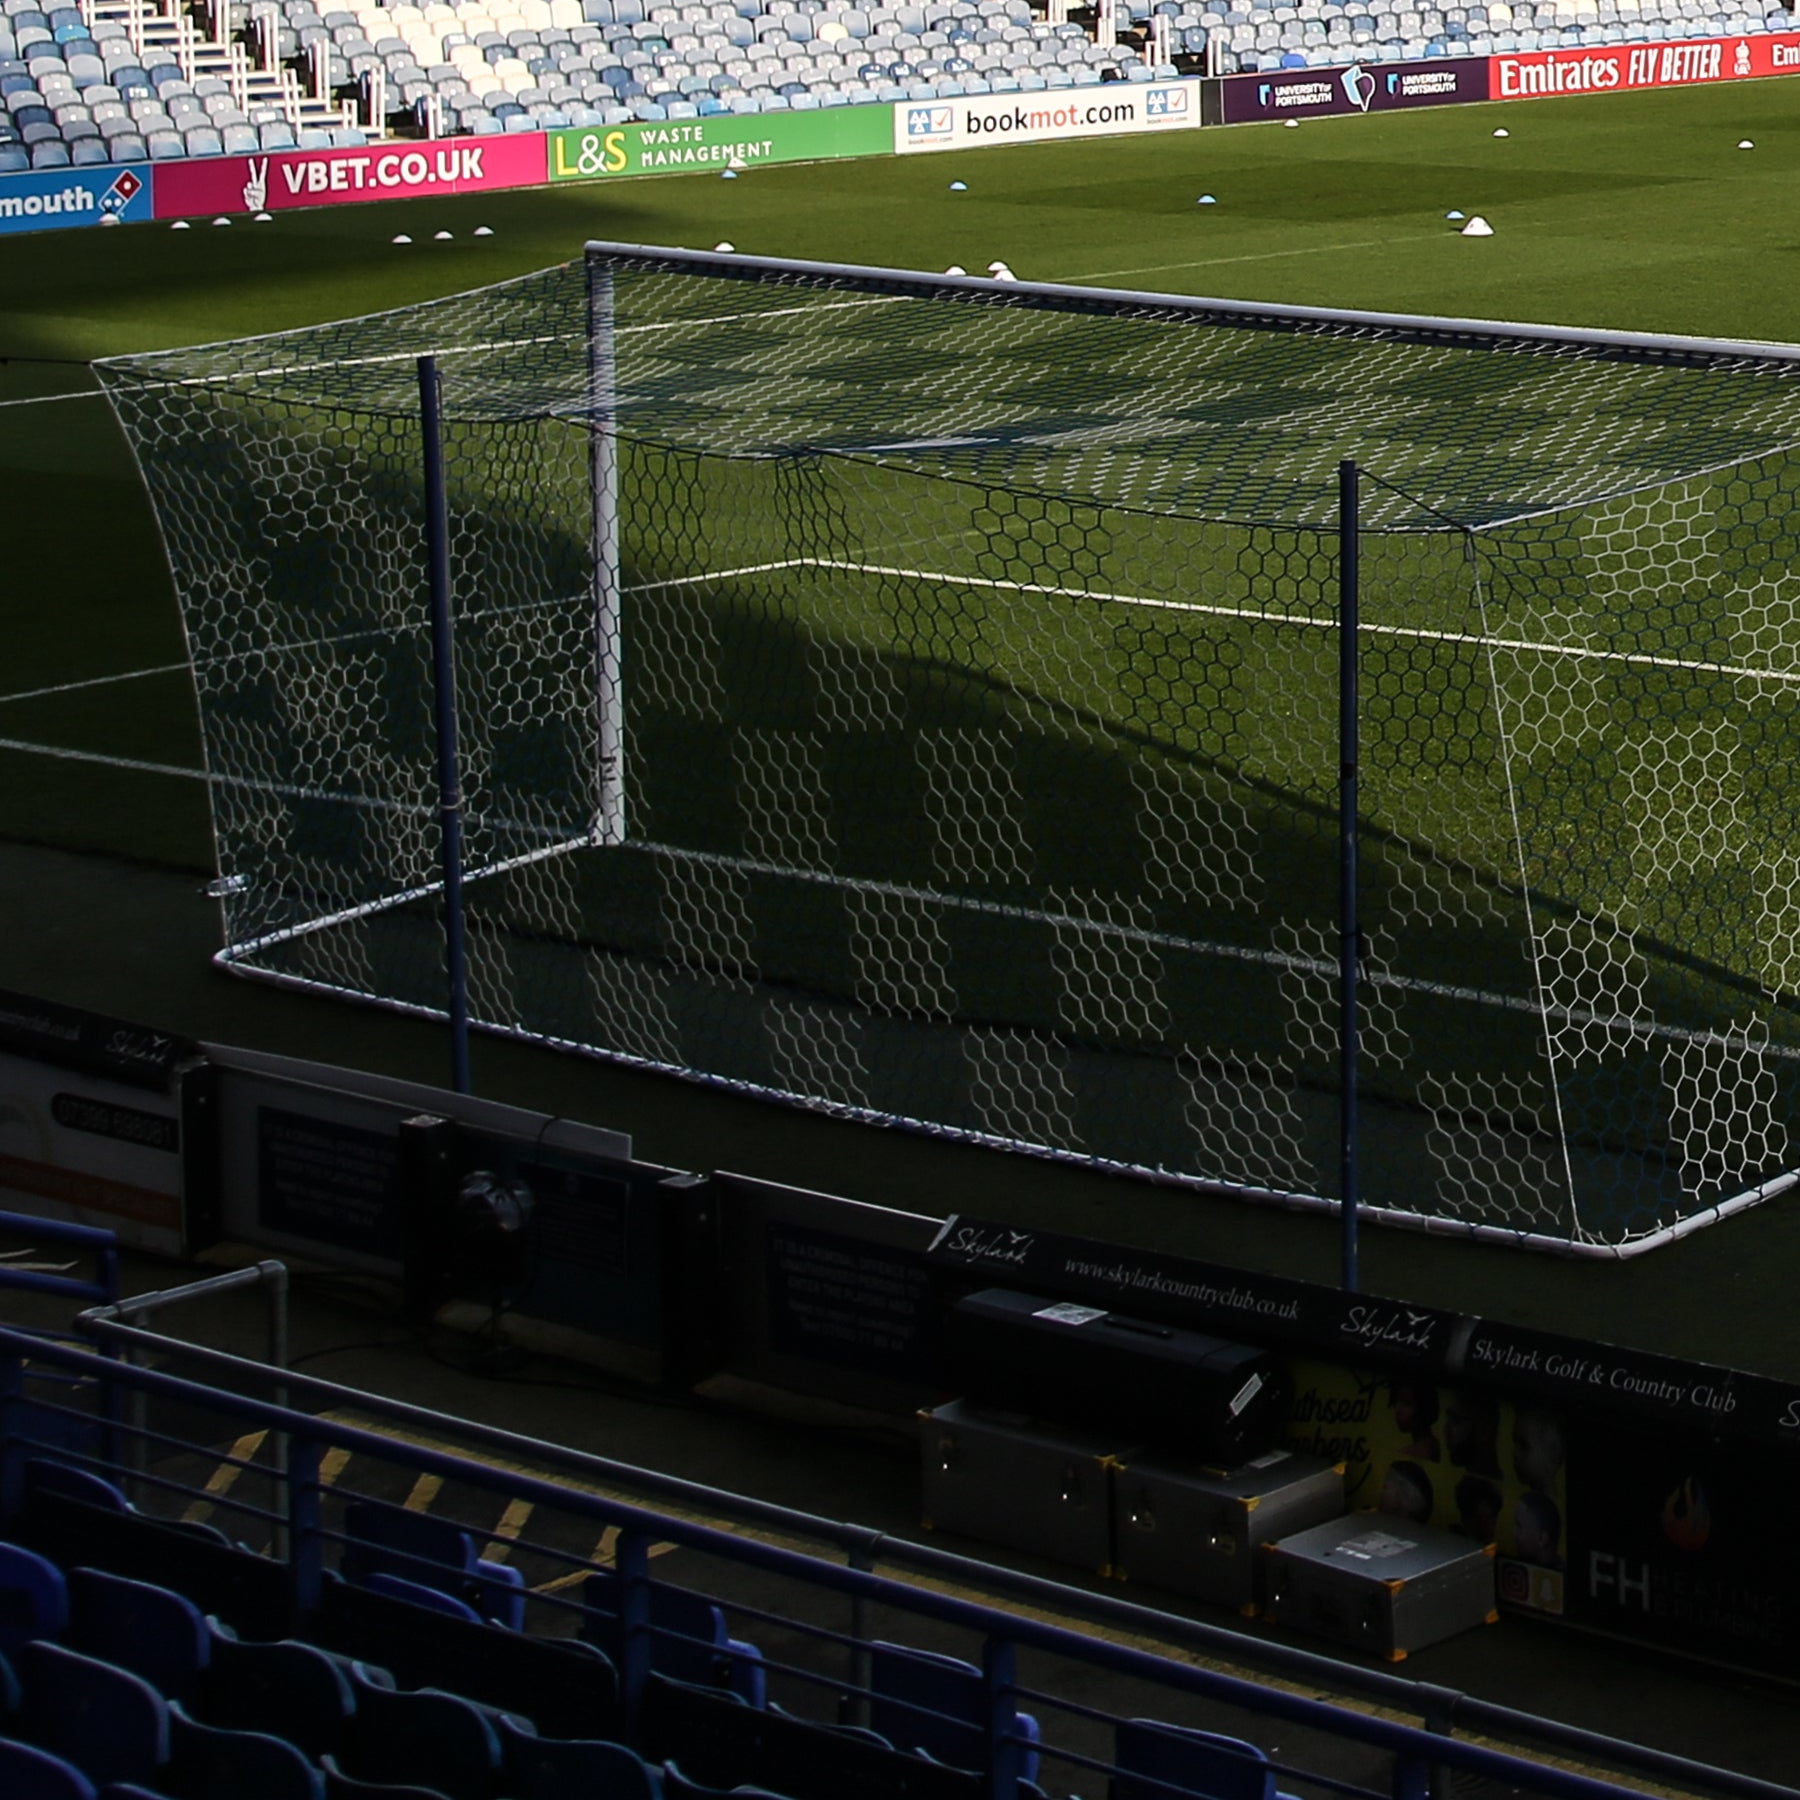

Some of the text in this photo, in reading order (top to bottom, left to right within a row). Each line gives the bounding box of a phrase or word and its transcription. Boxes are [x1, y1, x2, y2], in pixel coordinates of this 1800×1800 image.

[1402, 83, 1456, 96] PORTSMOUTH
[1500, 43, 1722, 95] Emirates FLY BETTER
[965, 99, 1136, 136] bookmot.com
[1275, 93, 1333, 107] PORTSMOUTH
[556, 131, 627, 176] L&S
[640, 126, 703, 144] WASTE
[640, 140, 773, 166] MANAGEMENT
[281, 146, 485, 193] VBET.CO.UK
[948, 1227, 1035, 1264] Skylark
[1064, 1255, 1299, 1321] www.skylarkcountryclub.co.uk
[1340, 1304, 1432, 1350] Skylark
[1472, 1338, 1737, 1413] Skylark Golf & Country Club
[1588, 1549, 1651, 1613] FH
